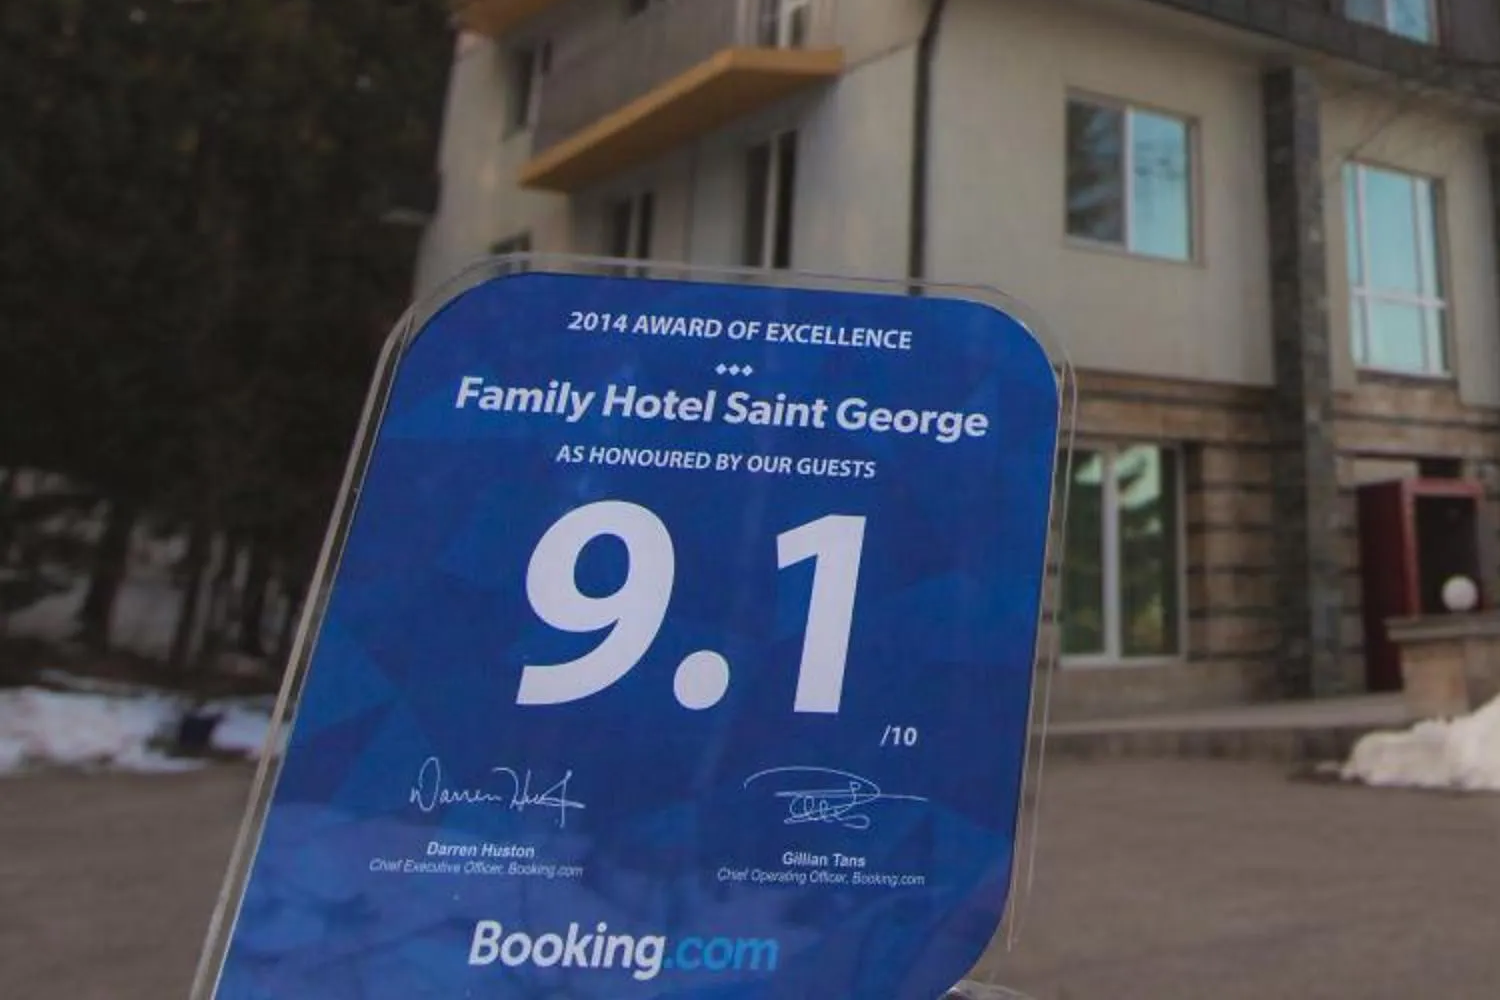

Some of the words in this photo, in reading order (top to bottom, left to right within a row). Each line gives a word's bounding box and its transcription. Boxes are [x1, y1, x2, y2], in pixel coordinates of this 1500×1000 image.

[567, 311, 628, 333] 2014
[632, 314, 723, 338] AWARD
[727, 320, 761, 341] OF
[765, 322, 913, 350] EXCELLENCE
[455, 375, 596, 423] Family
[601, 383, 717, 422] Hotel
[723, 391, 829, 429] Saint
[835, 397, 989, 443] George
[556, 444, 585, 463] AS
[588, 446, 712, 470] HONOURED
[715, 453, 743, 471] BY
[747, 455, 793, 474] OUR
[796, 457, 876, 479] GUESTS
[515, 499, 867, 714] 9.1
[880, 725, 918, 747] /10
[426, 841, 478, 857] Darren
[481, 843, 535, 858] Huston
[782, 851, 829, 868] Gillian
[832, 852, 866, 868] Tans
[467, 919, 780, 981] Booking.com
